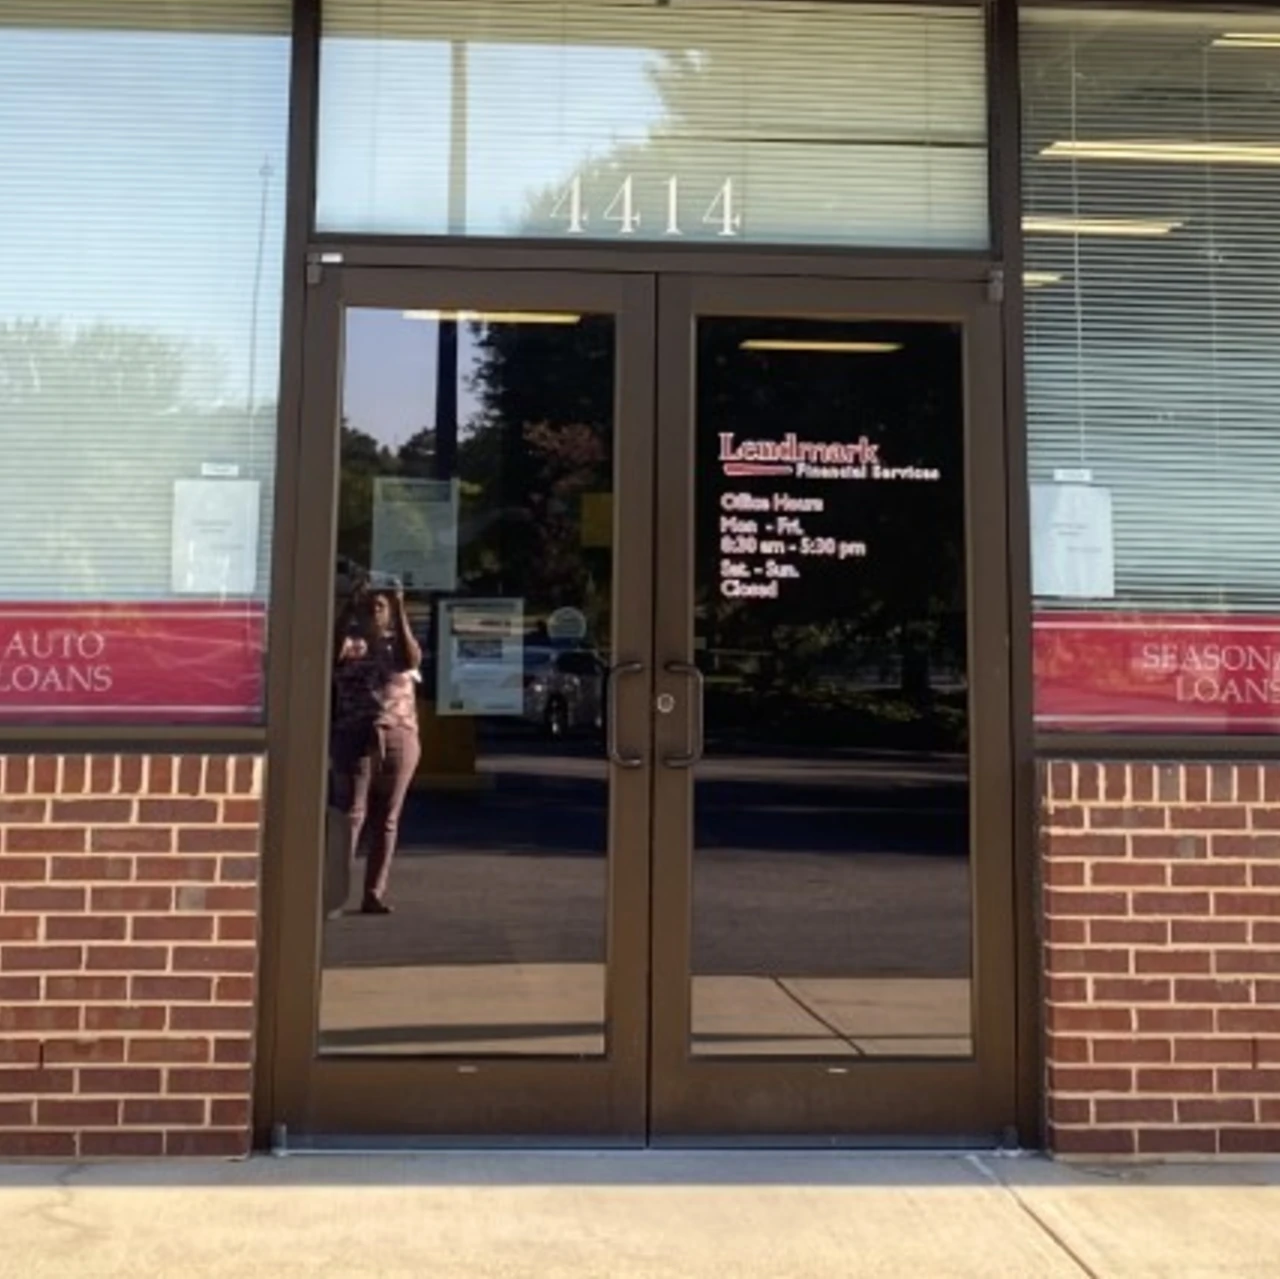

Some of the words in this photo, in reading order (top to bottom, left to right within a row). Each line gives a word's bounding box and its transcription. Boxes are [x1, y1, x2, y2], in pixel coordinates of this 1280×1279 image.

[549, 173, 741, 236] 4414
[718, 432, 880, 464] Lendmark
[795, 463, 867, 479] Financial
[871, 467, 940, 480] Services
[720, 492, 770, 512] Office
[773, 493, 824, 512] Hours
[776, 517, 804, 535] Fri.
[799, 537, 836, 555] 5:30
[838, 541, 866, 559] pm
[765, 560, 800, 578] Sun.
[720, 579, 778, 598] Closed
[3, 629, 105, 659] AUTO
